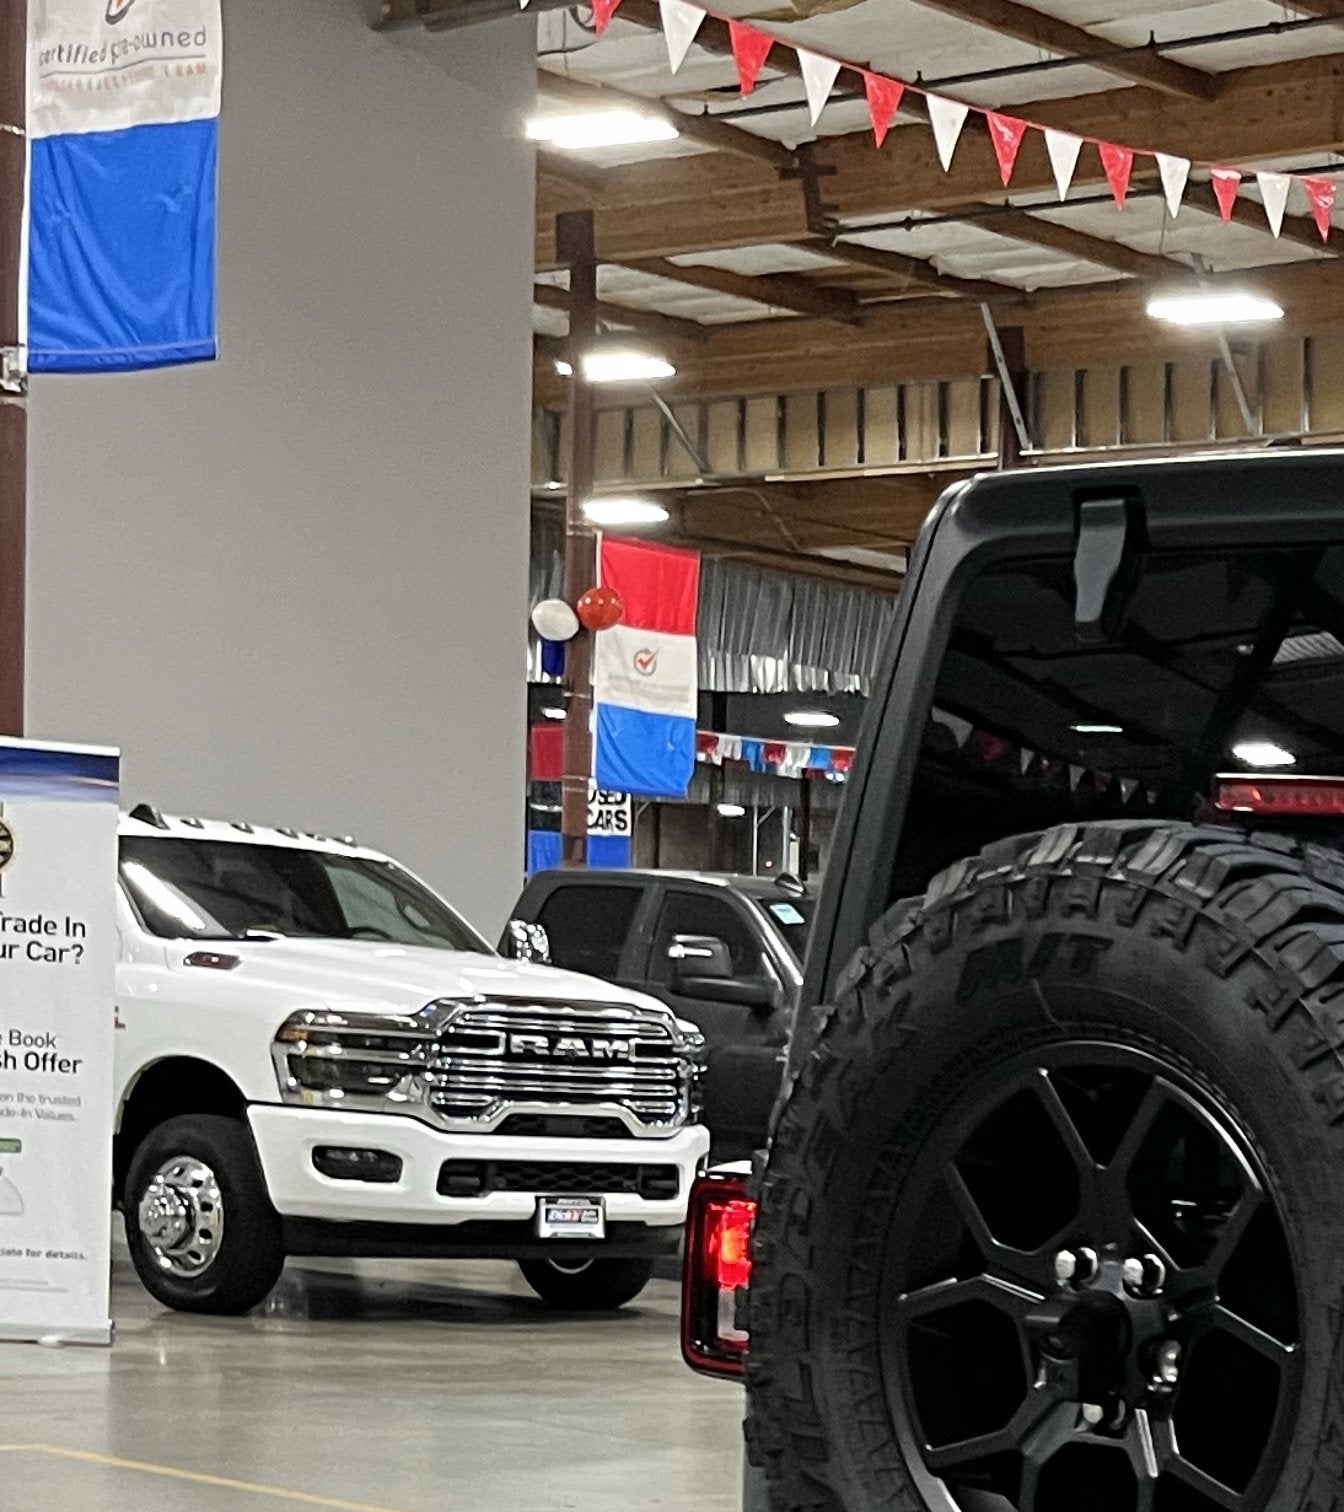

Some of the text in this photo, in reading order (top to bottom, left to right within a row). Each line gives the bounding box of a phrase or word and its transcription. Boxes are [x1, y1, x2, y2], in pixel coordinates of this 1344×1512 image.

[0, 911, 85, 938] rade In
[26, 940, 84, 964] Car?
[9, 1029, 57, 1049] Book
[511, 1033, 629, 1058] RAM
[24, 1051, 83, 1074] Offer
